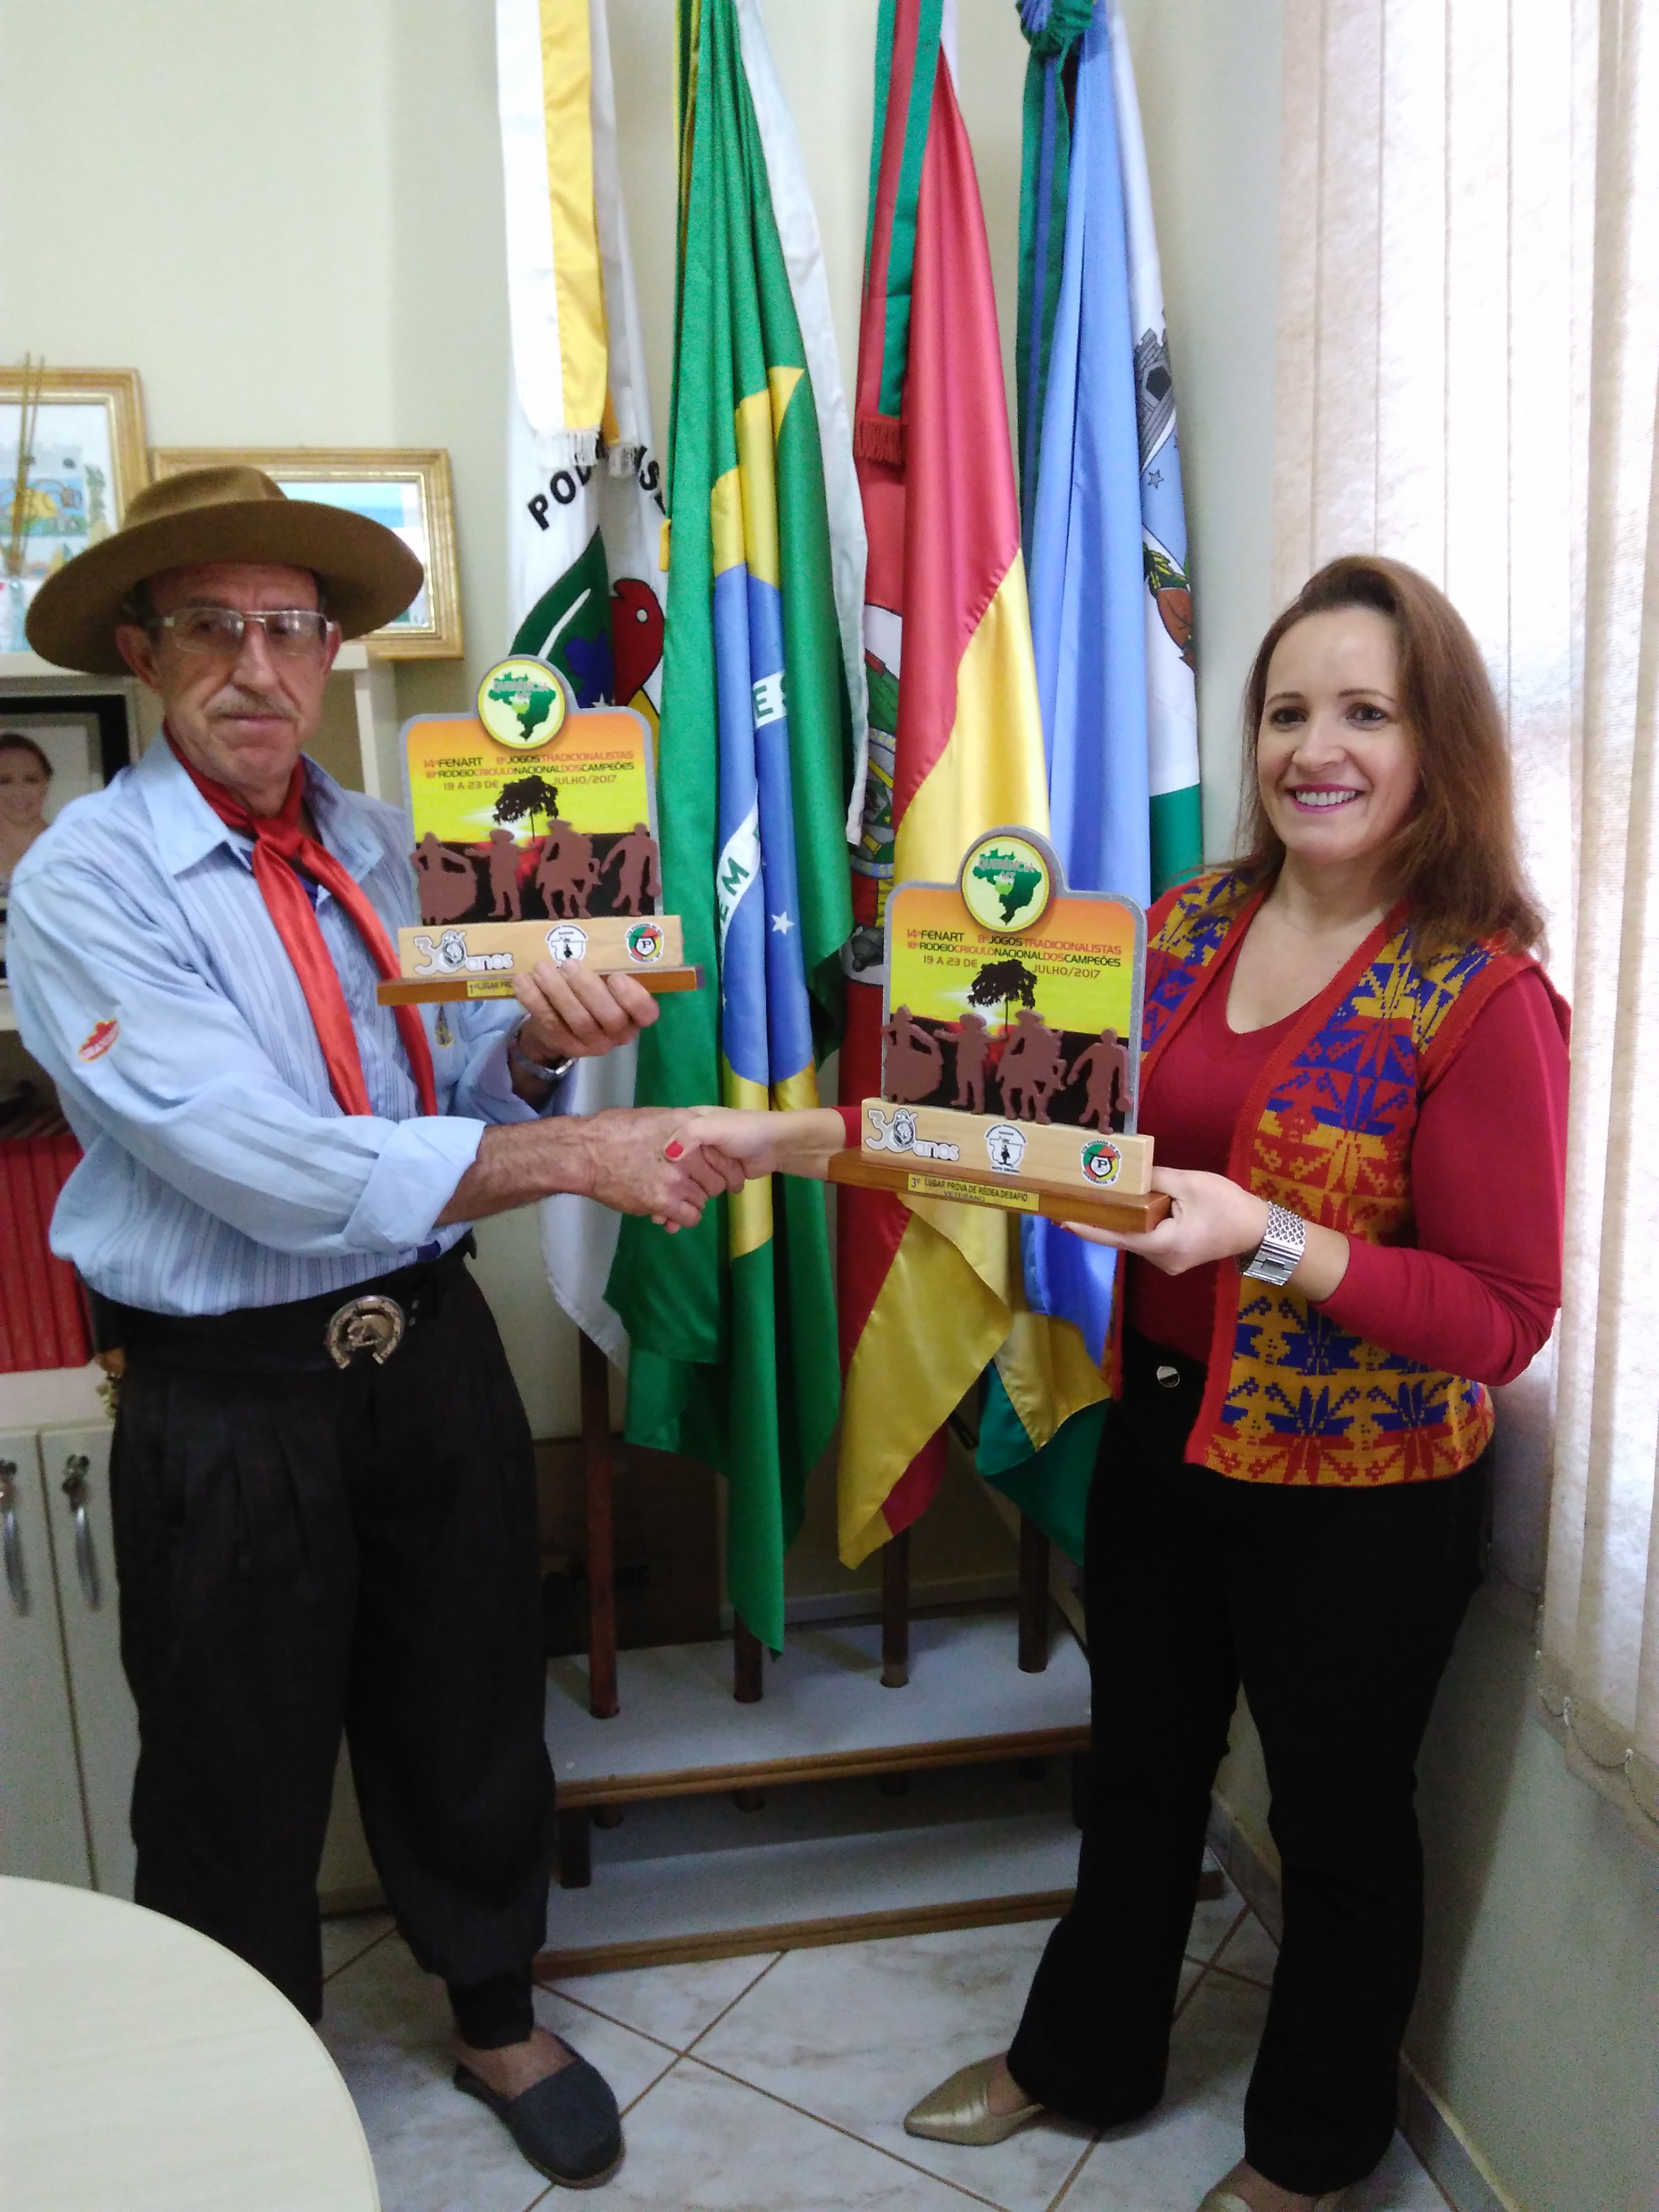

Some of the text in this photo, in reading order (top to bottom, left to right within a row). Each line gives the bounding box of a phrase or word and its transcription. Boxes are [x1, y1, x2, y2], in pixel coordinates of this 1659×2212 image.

[439, 757, 483, 767] FENART
[443, 782, 454, 790] 19
[467, 781, 481, 790] 23
[484, 780, 499, 789] DE
[554, 774, 617, 785] JULHO/2017
[978, 857, 1035, 873] QUERÊNCIA
[921, 929, 965, 942] FENART
[988, 935, 1023, 946] JOGOS
[466, 953, 514, 971] anos
[923, 955, 1101, 979] 19 A 23 DE JULHO/2017
[913, 1138, 960, 1161] anos
[1096, 1159, 1108, 1168] P
[911, 1177, 920, 1188] 3º
[925, 1178, 945, 1188] LUGAR
[947, 1182, 967, 1192] PROVA
[968, 1185, 978, 1194] DE
[1000, 1189, 1028, 1202] DESAFIO
